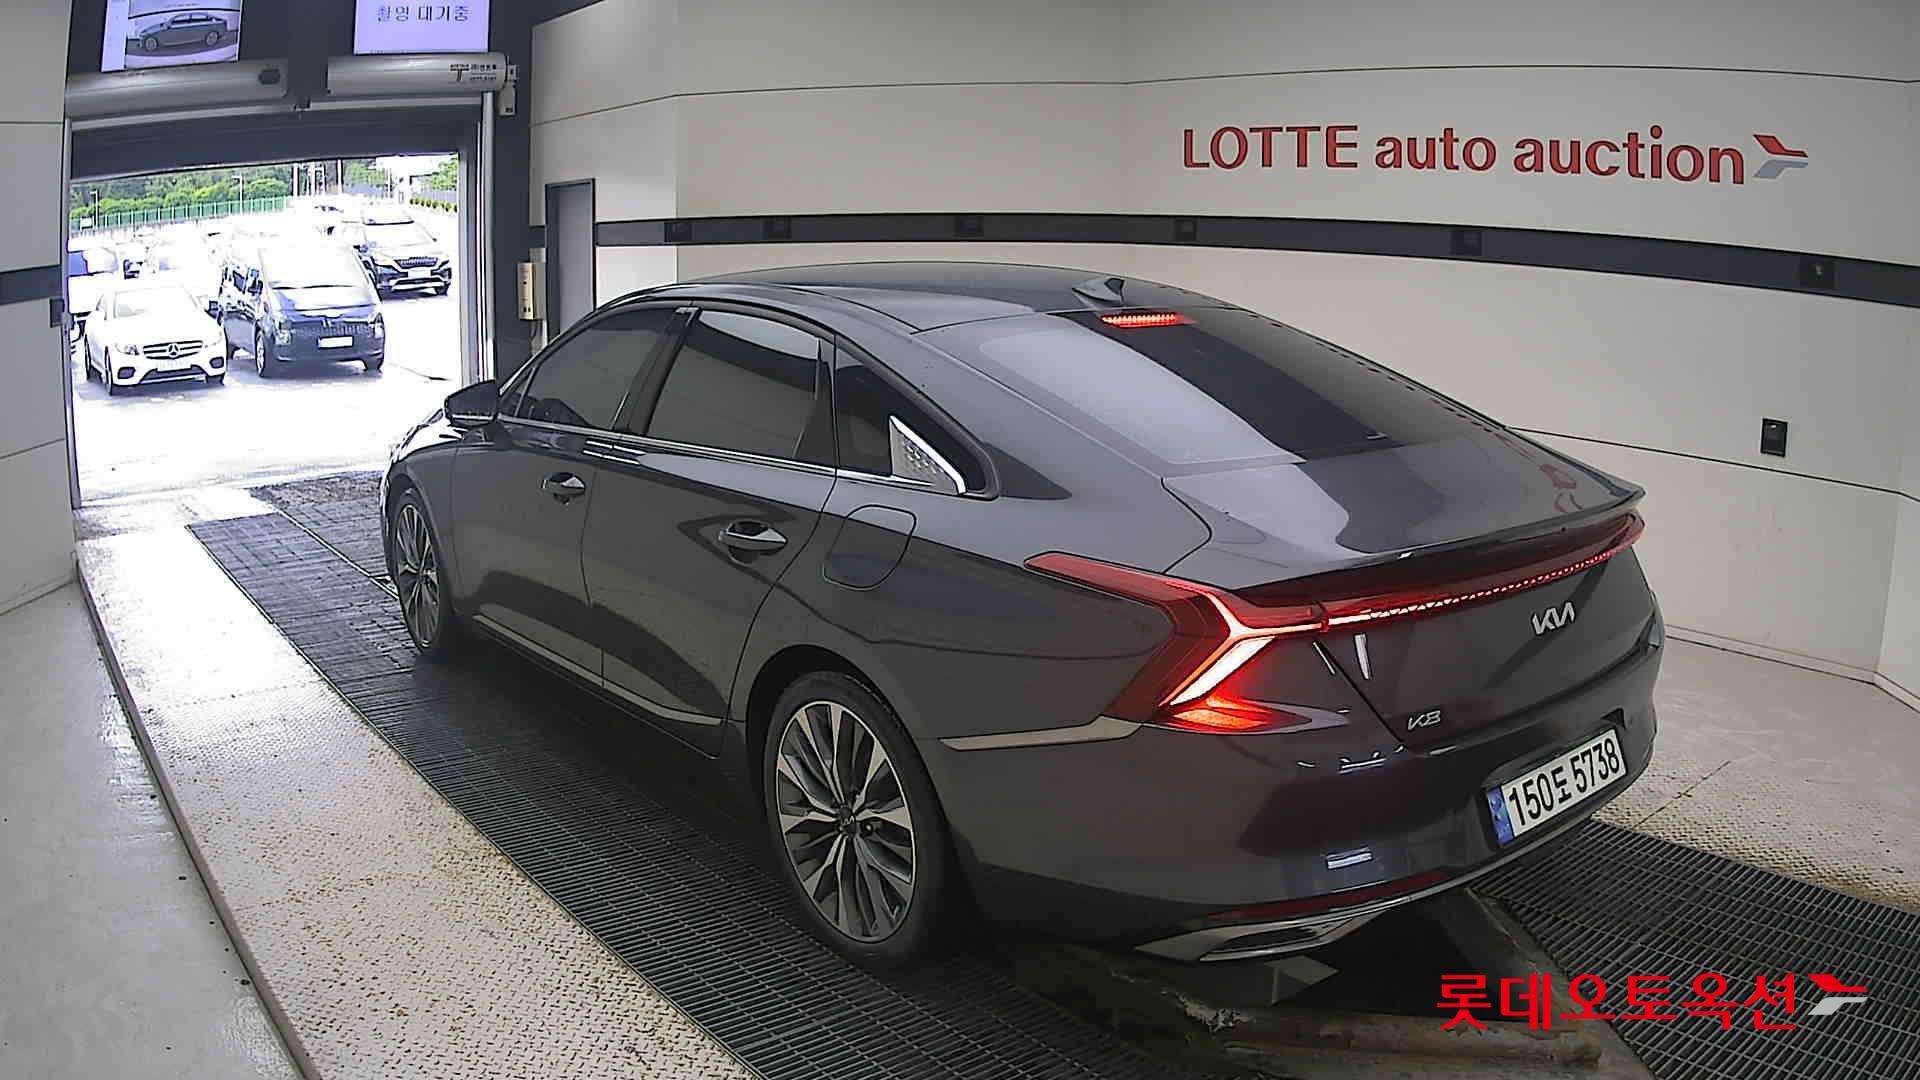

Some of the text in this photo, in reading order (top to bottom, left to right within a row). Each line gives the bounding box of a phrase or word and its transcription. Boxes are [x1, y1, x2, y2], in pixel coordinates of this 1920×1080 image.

[418, 5, 470, 22] 대기중
[1183, 125, 1745, 185] LOTTE auto auction
[1407, 709, 1441, 730] K8
[1508, 737, 1620, 827] 150도 5738
